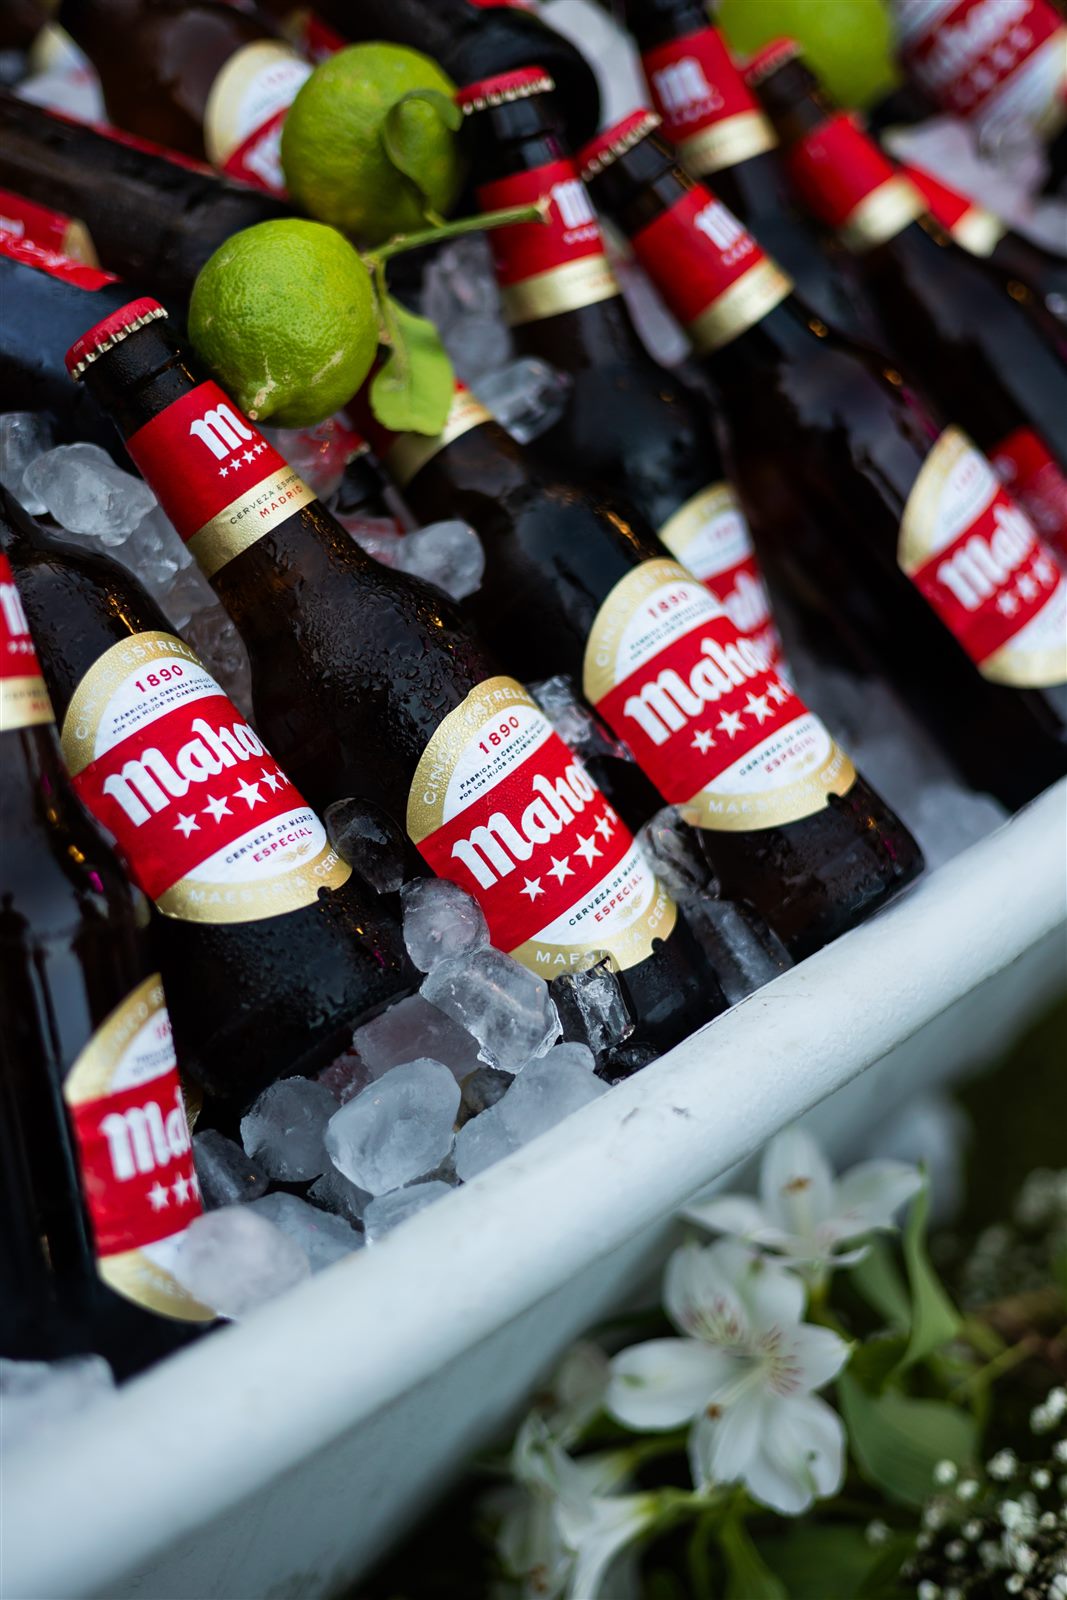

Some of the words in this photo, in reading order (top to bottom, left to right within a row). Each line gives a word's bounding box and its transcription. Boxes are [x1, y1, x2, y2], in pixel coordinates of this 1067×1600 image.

[230, 490, 275, 525] CERVEZA
[260, 485, 303, 519] MADRID
[135, 664, 184, 693] 1890
[479, 716, 519, 754] 1890
[459, 789, 473, 801] POR
[487, 761, 507, 780] HIJOS
[225, 831, 274, 864] CERVEZA
[276, 824, 288, 834] DE
[288, 813, 314, 827] MADRID
[252, 827, 313, 863] ESPECIAL
[568, 888, 612, 926] CERVEZA
[612, 877, 623, 888] DE
[593, 875, 643, 923] ESPECIAL
